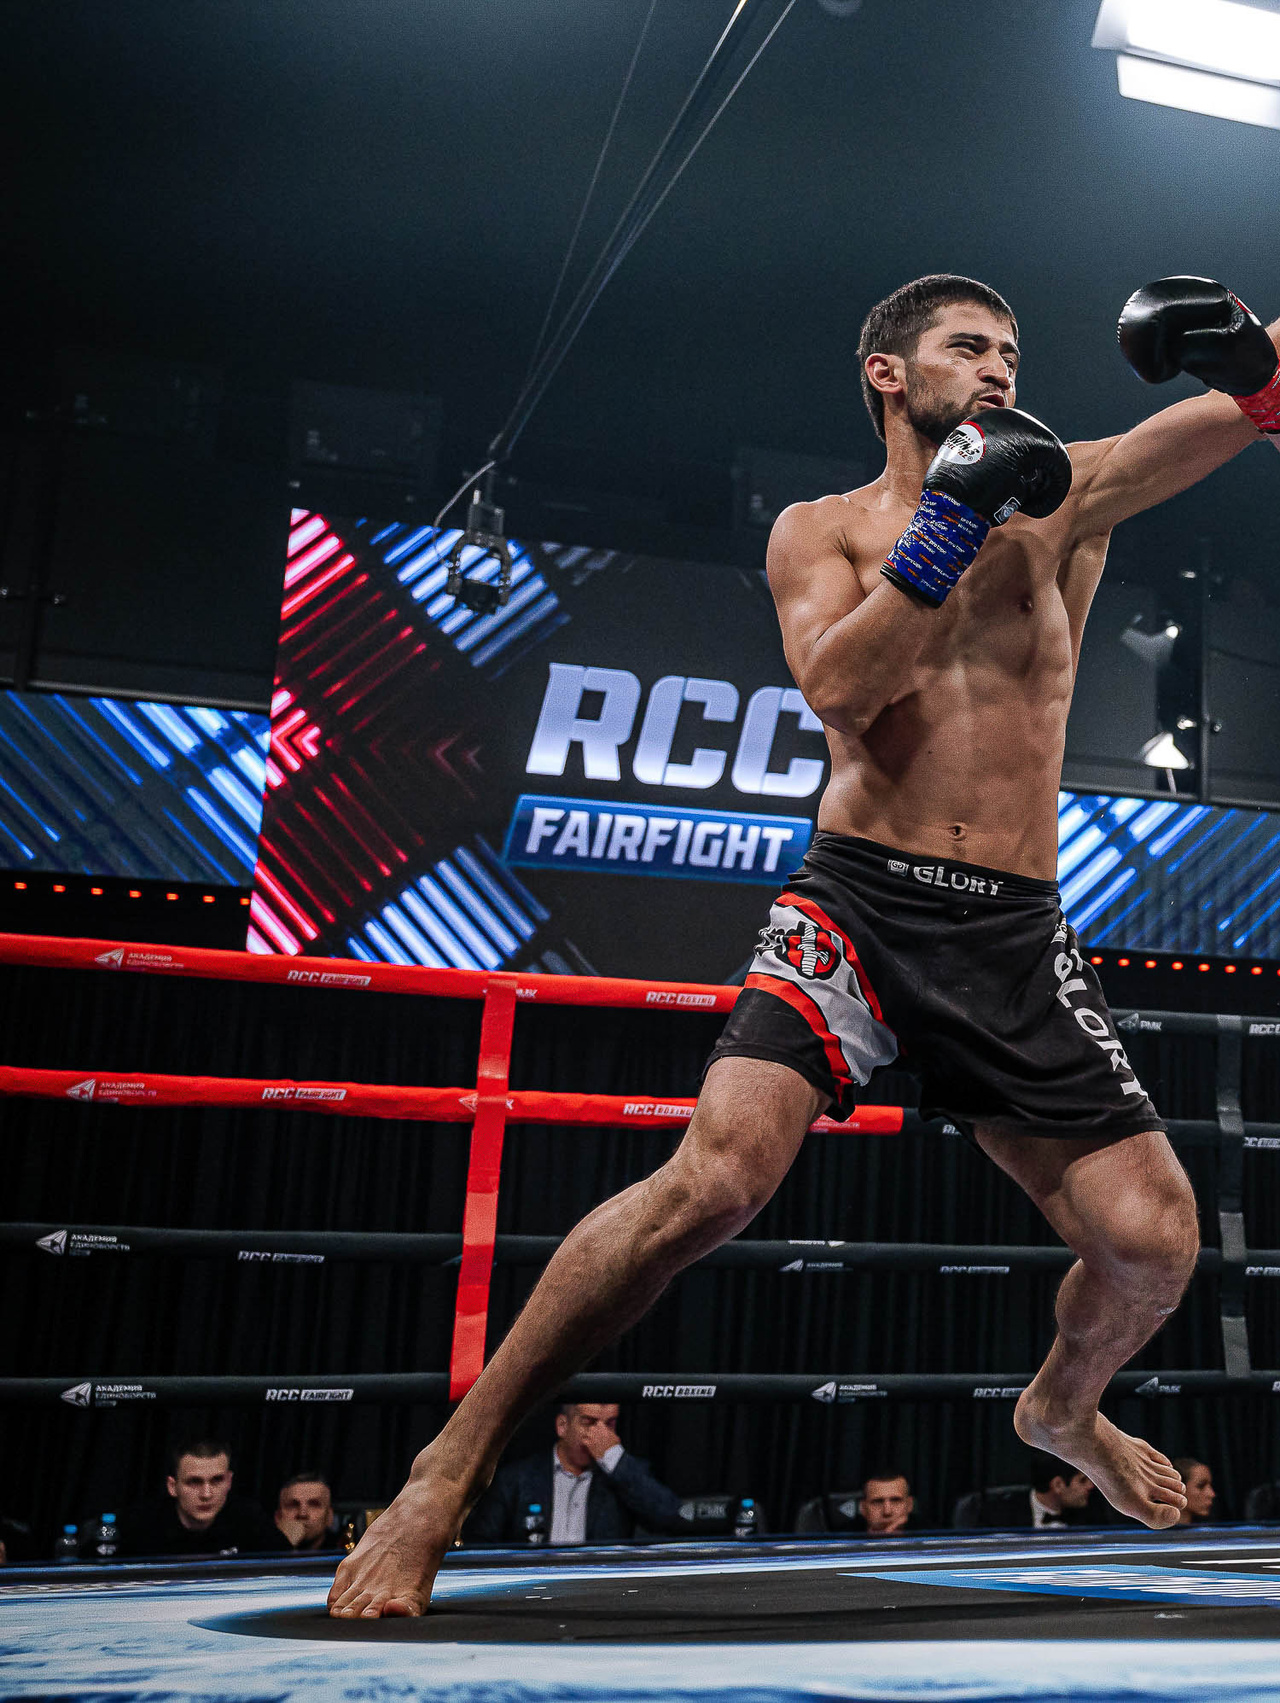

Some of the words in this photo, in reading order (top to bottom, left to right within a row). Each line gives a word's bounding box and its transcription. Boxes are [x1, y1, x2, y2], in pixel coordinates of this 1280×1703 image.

[526, 662, 826, 798] RCC
[525, 806, 795, 872] FAIRFIGHT
[913, 865, 1004, 896] GLORY
[646, 991, 677, 1004] RCC
[262, 1087, 296, 1100] RCC
[623, 1103, 654, 1116] RCC
[71, 1233, 118, 1243] АКАДЕМИЯ
[265, 1388, 300, 1401] RCC
[642, 1385, 674, 1398] RCC
[973, 1387, 1001, 1398] RCC
